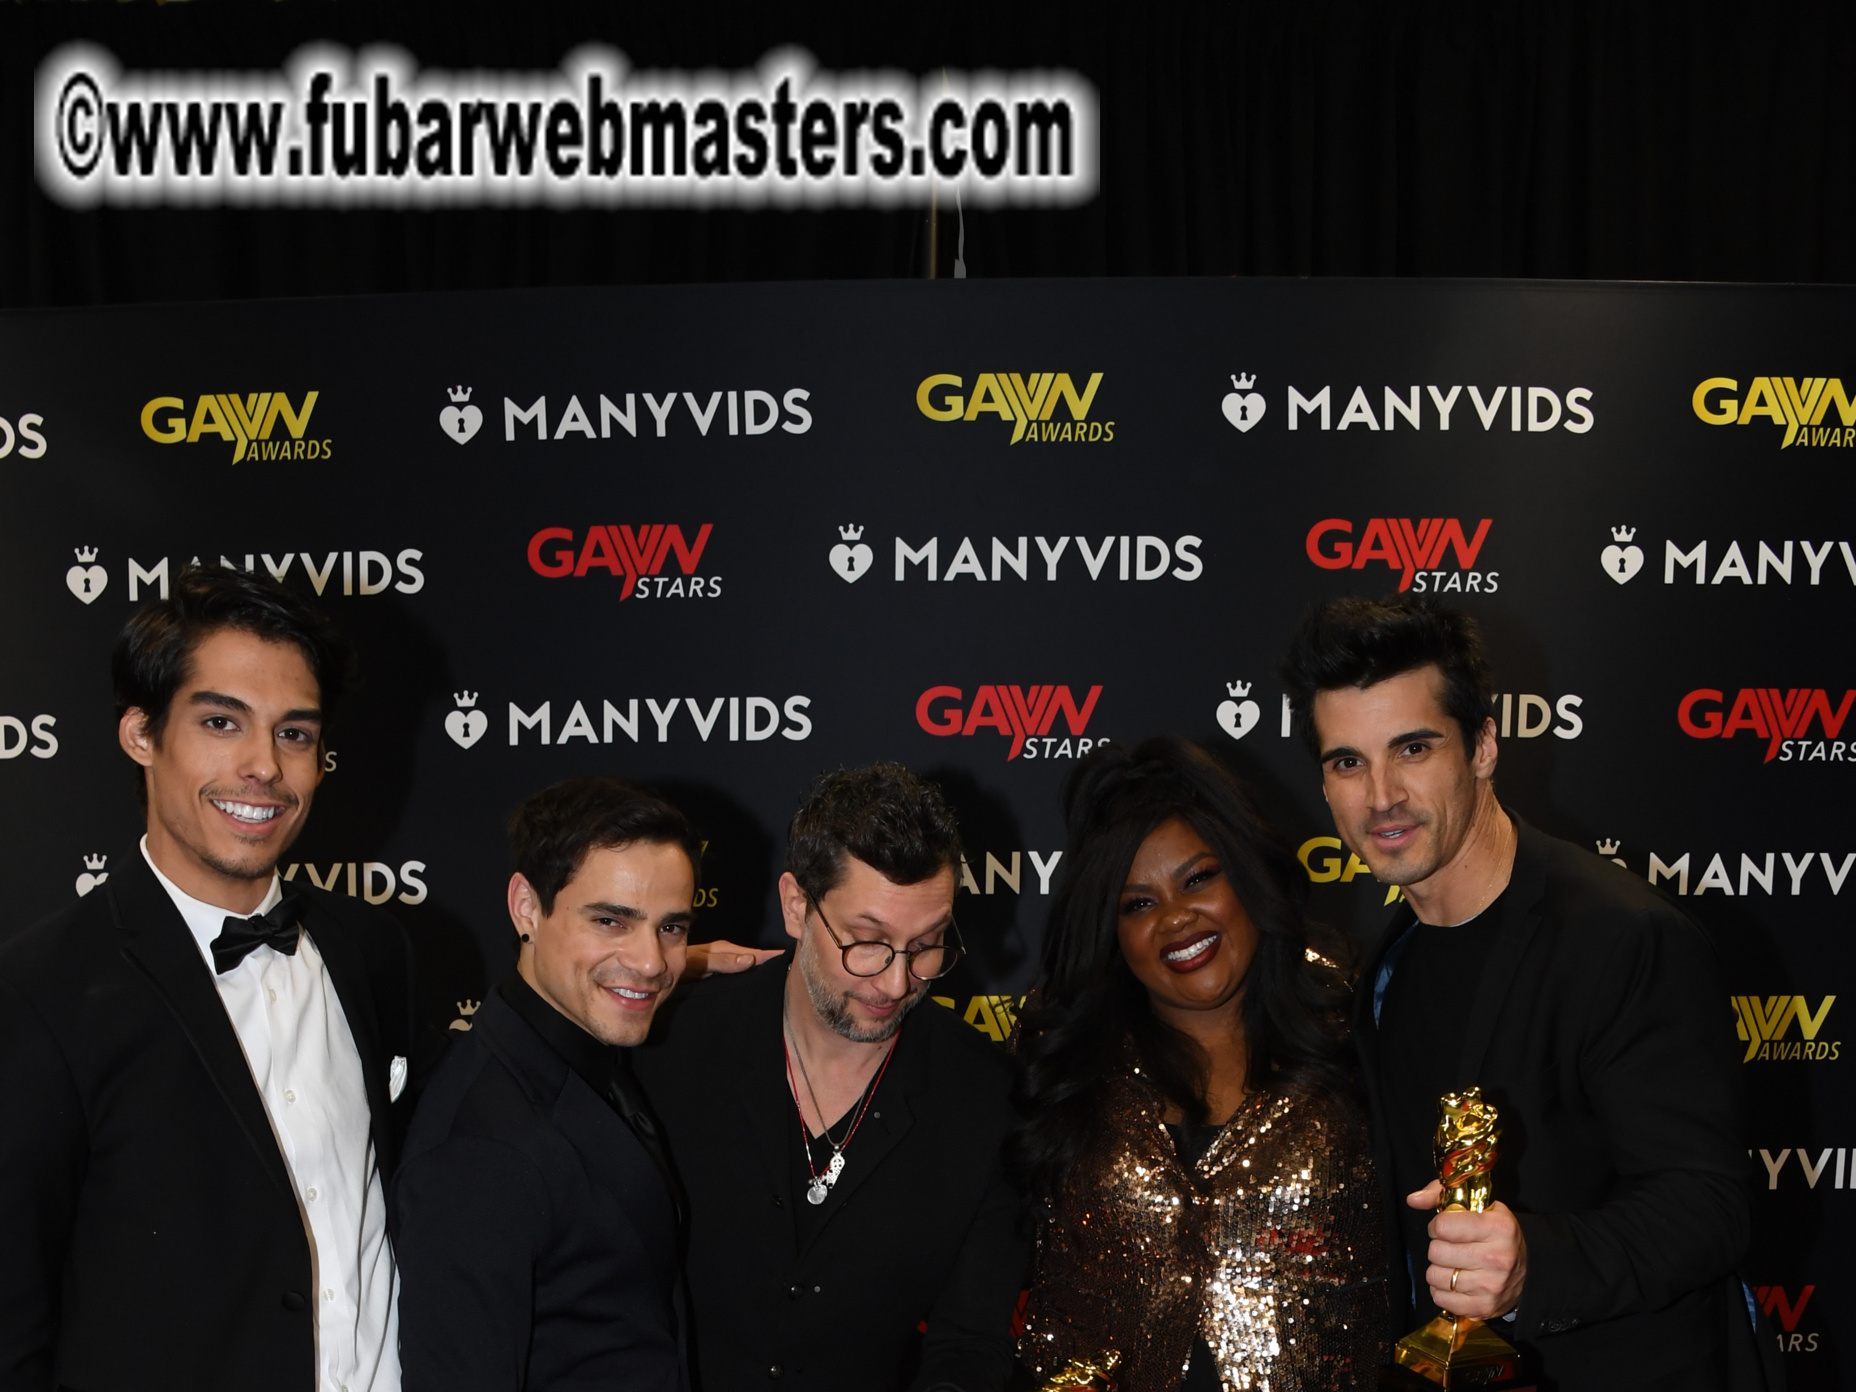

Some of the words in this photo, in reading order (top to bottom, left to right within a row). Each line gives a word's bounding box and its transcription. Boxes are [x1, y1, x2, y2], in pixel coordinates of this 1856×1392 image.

[503, 388, 813, 442] MANYVIDS
[1287, 385, 1595, 435] MANYVIDS
[1025, 420, 1115, 444] AWARDS
[248, 439, 332, 462] AWARDS
[128, 548, 425, 602] MYVIDS
[894, 534, 1203, 582] MANYVIDS
[636, 575, 723, 599] STARS
[1413, 571, 1500, 594] STARS
[508, 695, 813, 747] MANYVIDS
[1759, 1039, 1842, 1062] AWARDS
